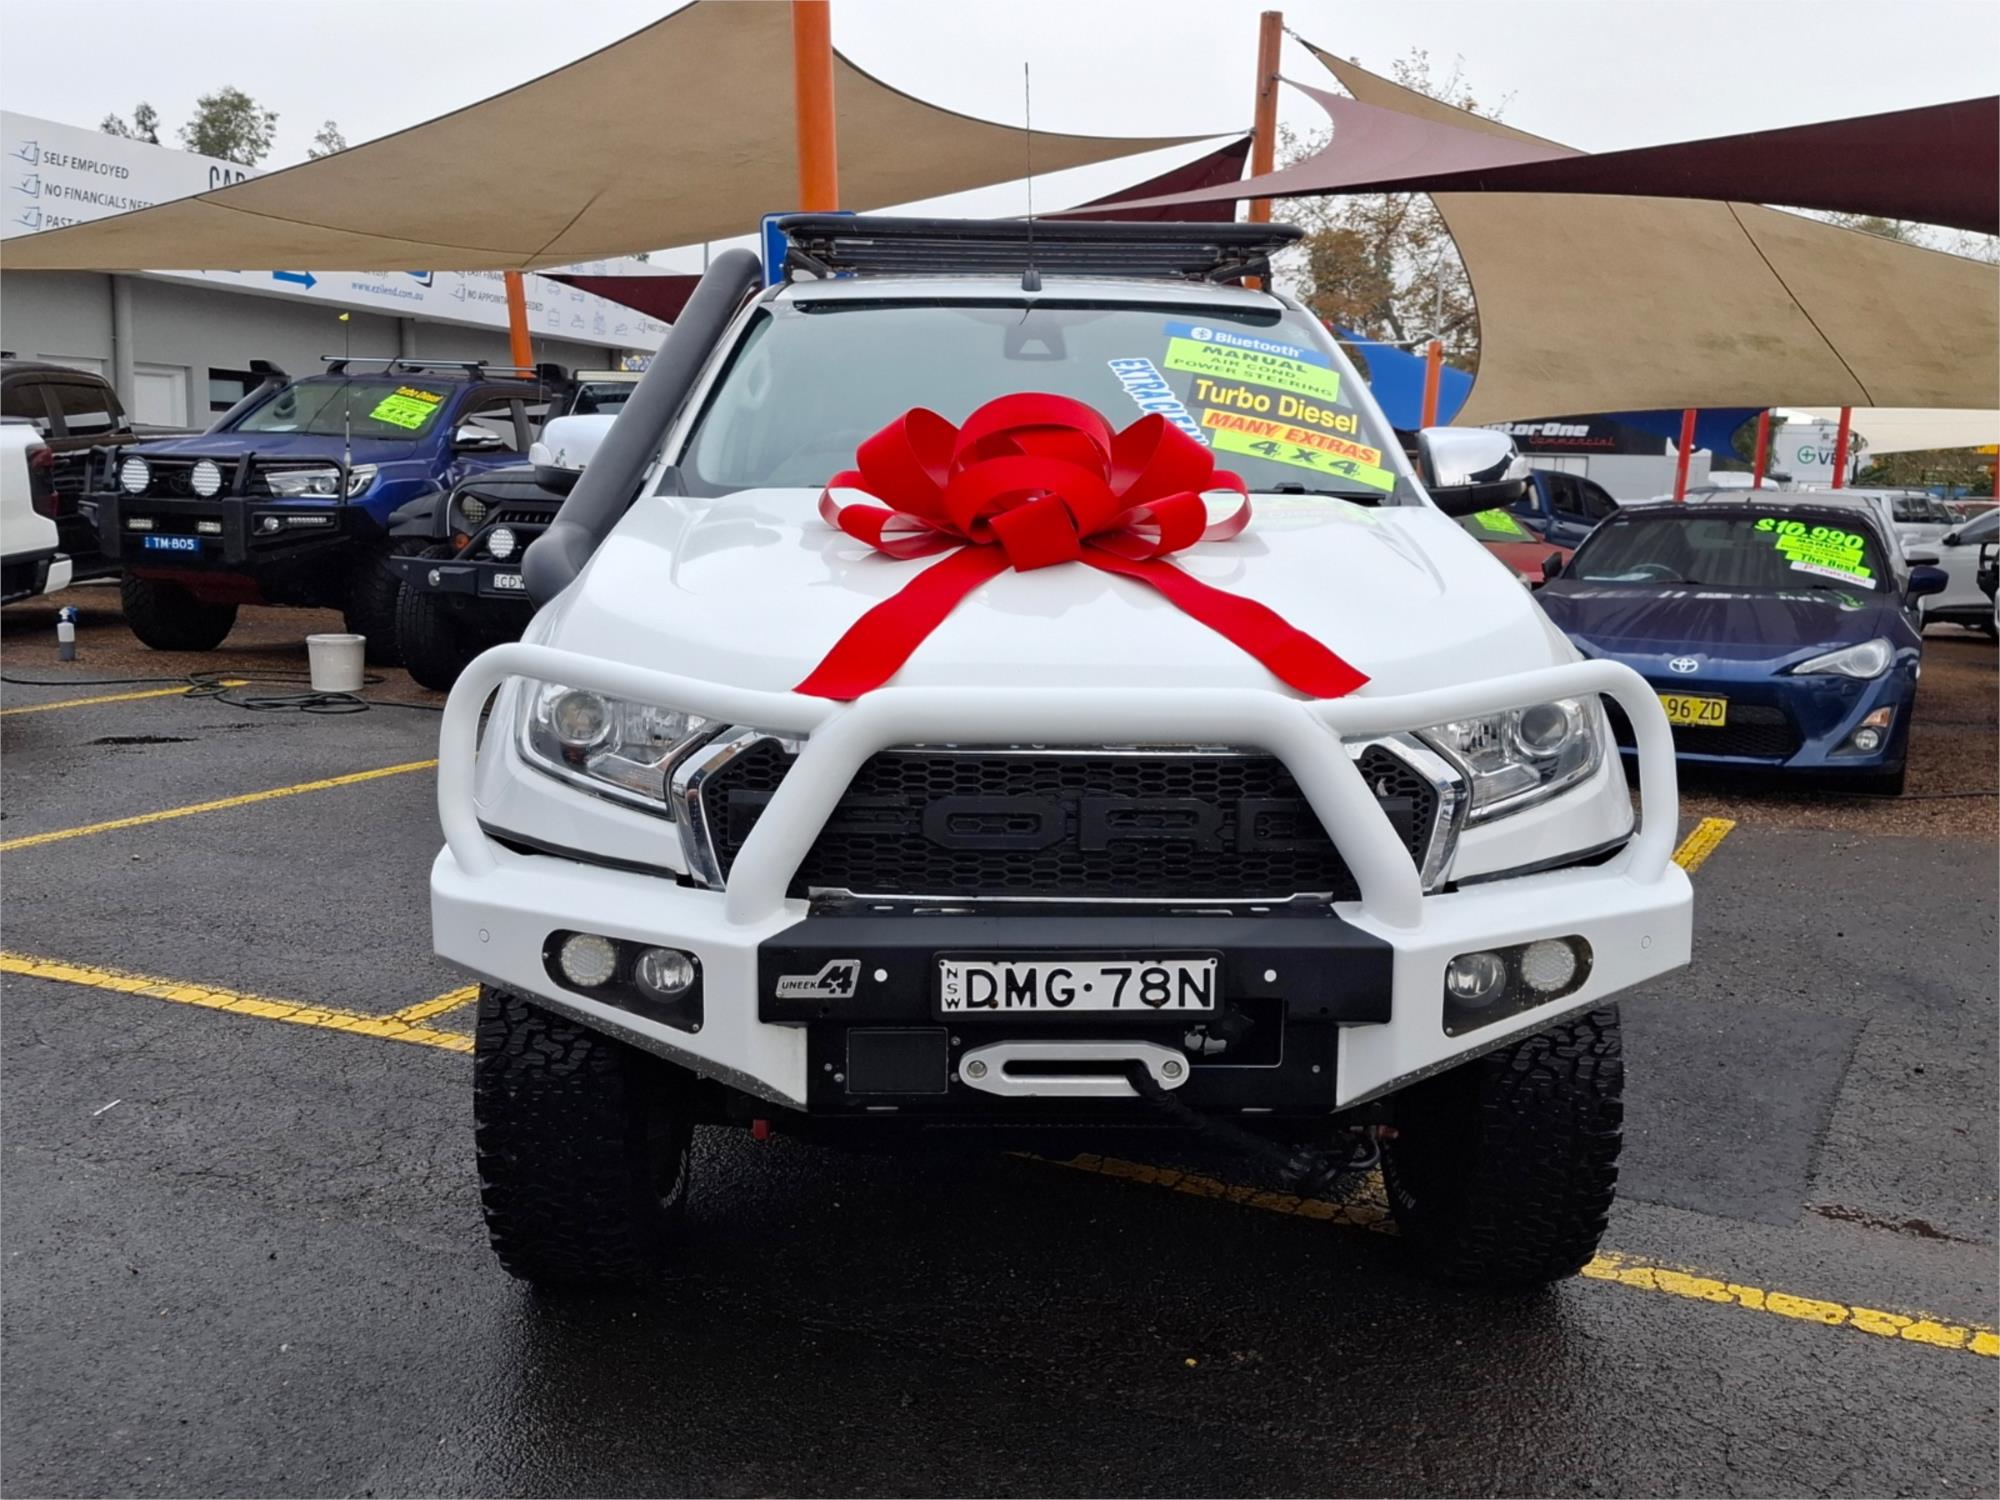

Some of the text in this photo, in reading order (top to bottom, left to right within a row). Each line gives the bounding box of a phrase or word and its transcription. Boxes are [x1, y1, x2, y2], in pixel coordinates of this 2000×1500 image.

[43, 151, 130, 179] SELF EMPLOYED
[44, 183, 62, 197] NO
[64, 187, 127, 210] FINANCIALS
[1215, 332, 1301, 358] Bluetooth
[1202, 346, 1309, 374] MANUAL
[1211, 357, 1240, 367] AIR
[1109, 359, 1173, 401] EXTRA
[1173, 358, 1333, 397] POWER STEERING
[1196, 379, 1358, 434] Turbo Diesel
[1206, 411, 1377, 464] MANY EXTRAS
[1249, 440, 1281, 458] 4
[1328, 460, 1361, 477] 4
[1802, 553, 1856, 573] The Best
